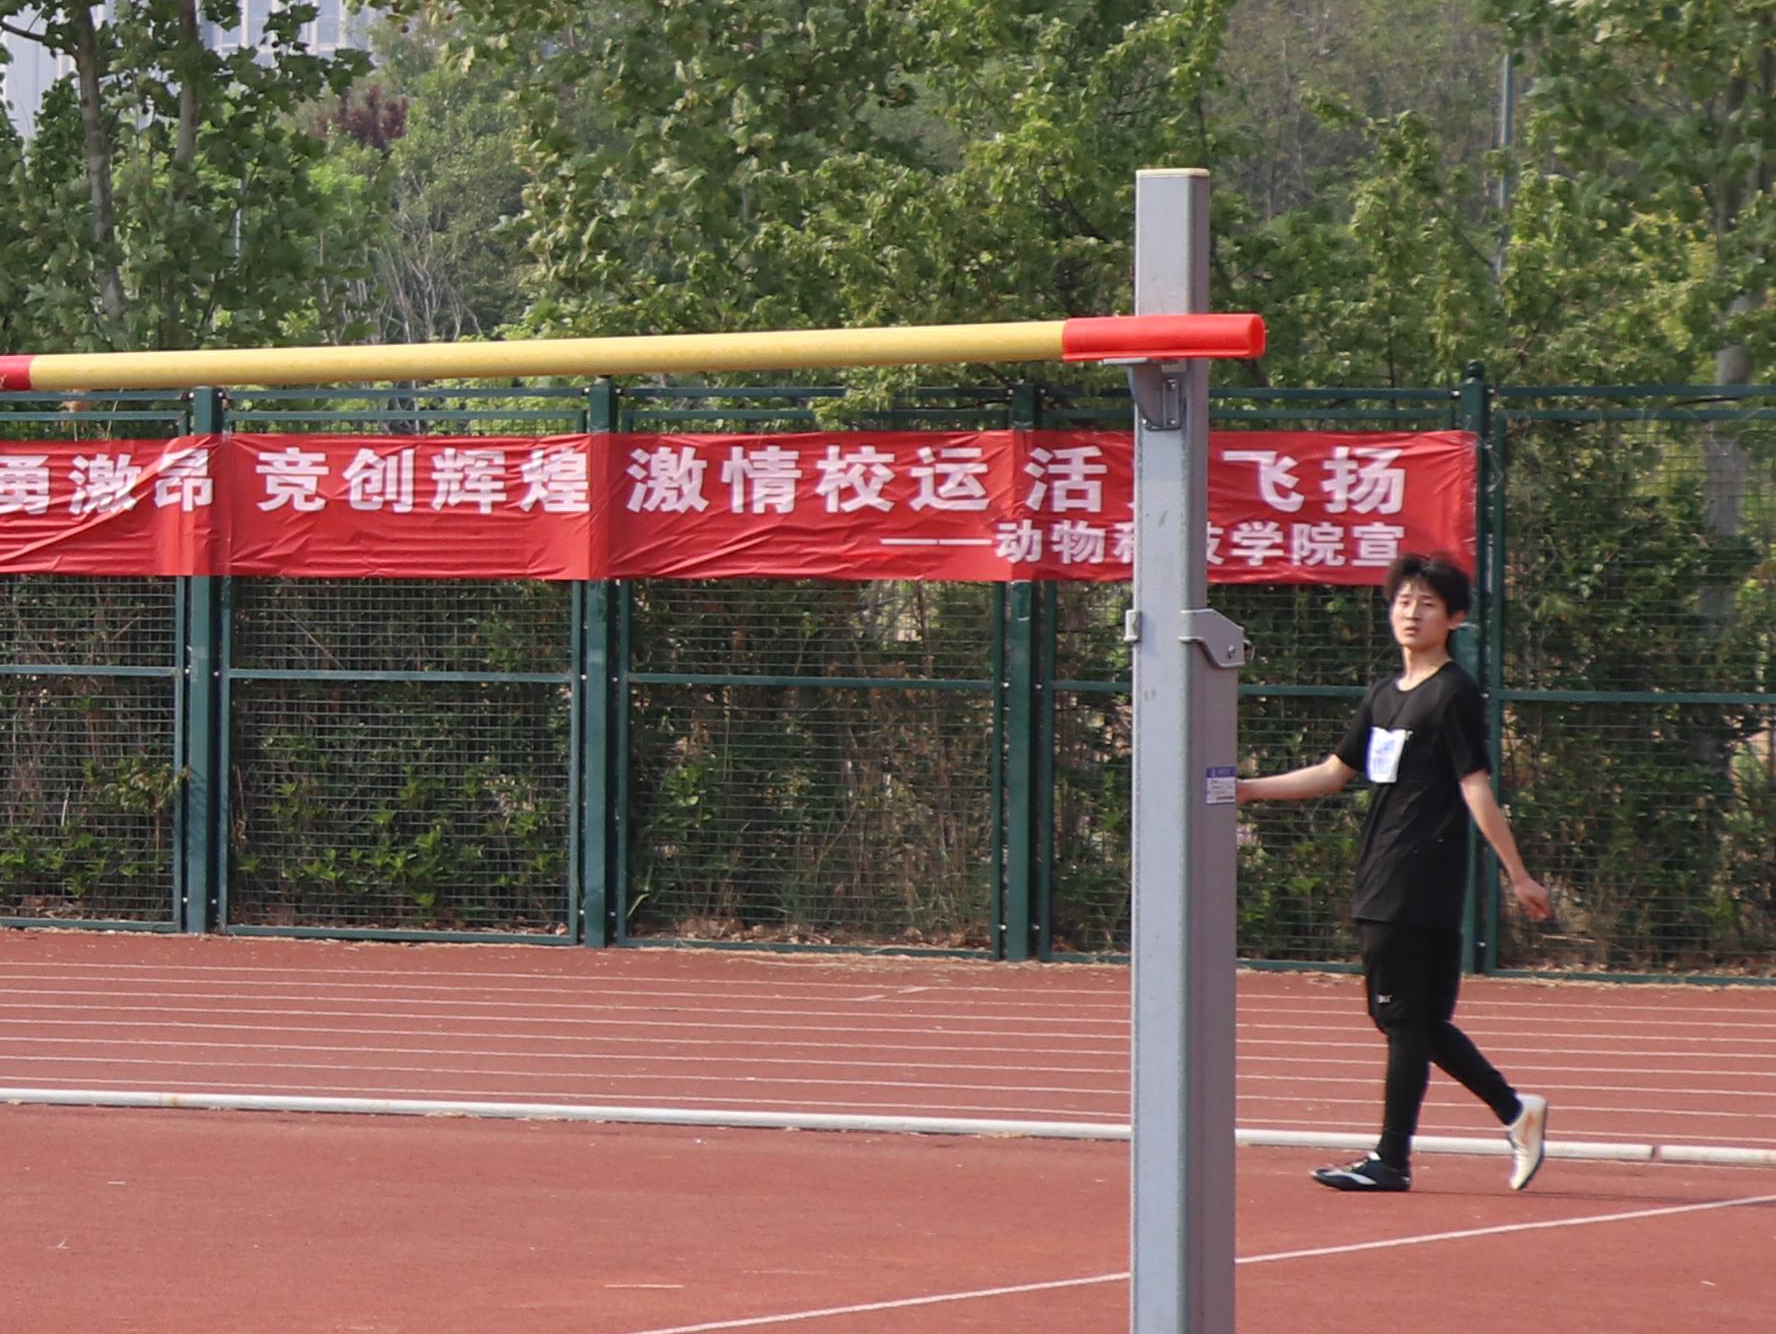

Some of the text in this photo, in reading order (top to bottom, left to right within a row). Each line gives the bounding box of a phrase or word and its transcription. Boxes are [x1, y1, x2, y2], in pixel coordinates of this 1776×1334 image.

[256, 446, 591, 515] 竞创辉煌
[626, 446, 992, 515] 激情校运
[1024, 446, 1407, 516] 活飞扬
